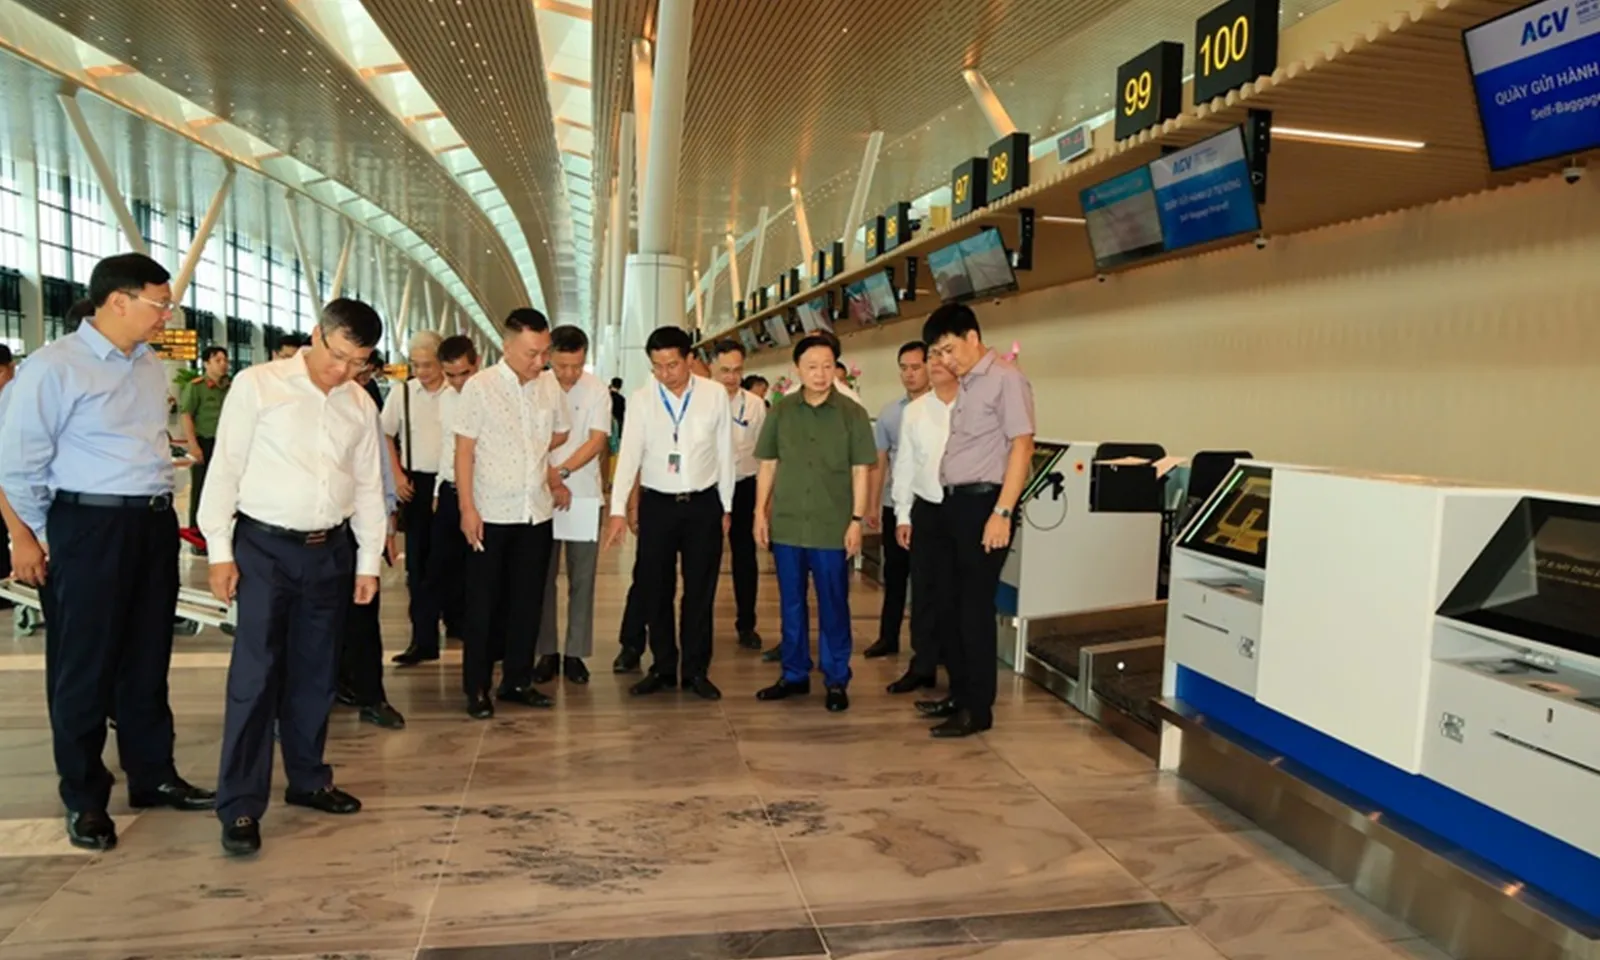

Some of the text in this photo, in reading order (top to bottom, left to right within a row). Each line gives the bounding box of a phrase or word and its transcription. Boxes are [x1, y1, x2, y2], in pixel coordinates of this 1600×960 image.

[1521, 6, 1569, 46] ACV
[1200, 15, 1248, 76] 100
[1556, 62, 1599, 87] HÀNH
[1125, 70, 1151, 116] 99
[992, 151, 1008, 184] 98
[955, 174, 969, 204] 97
